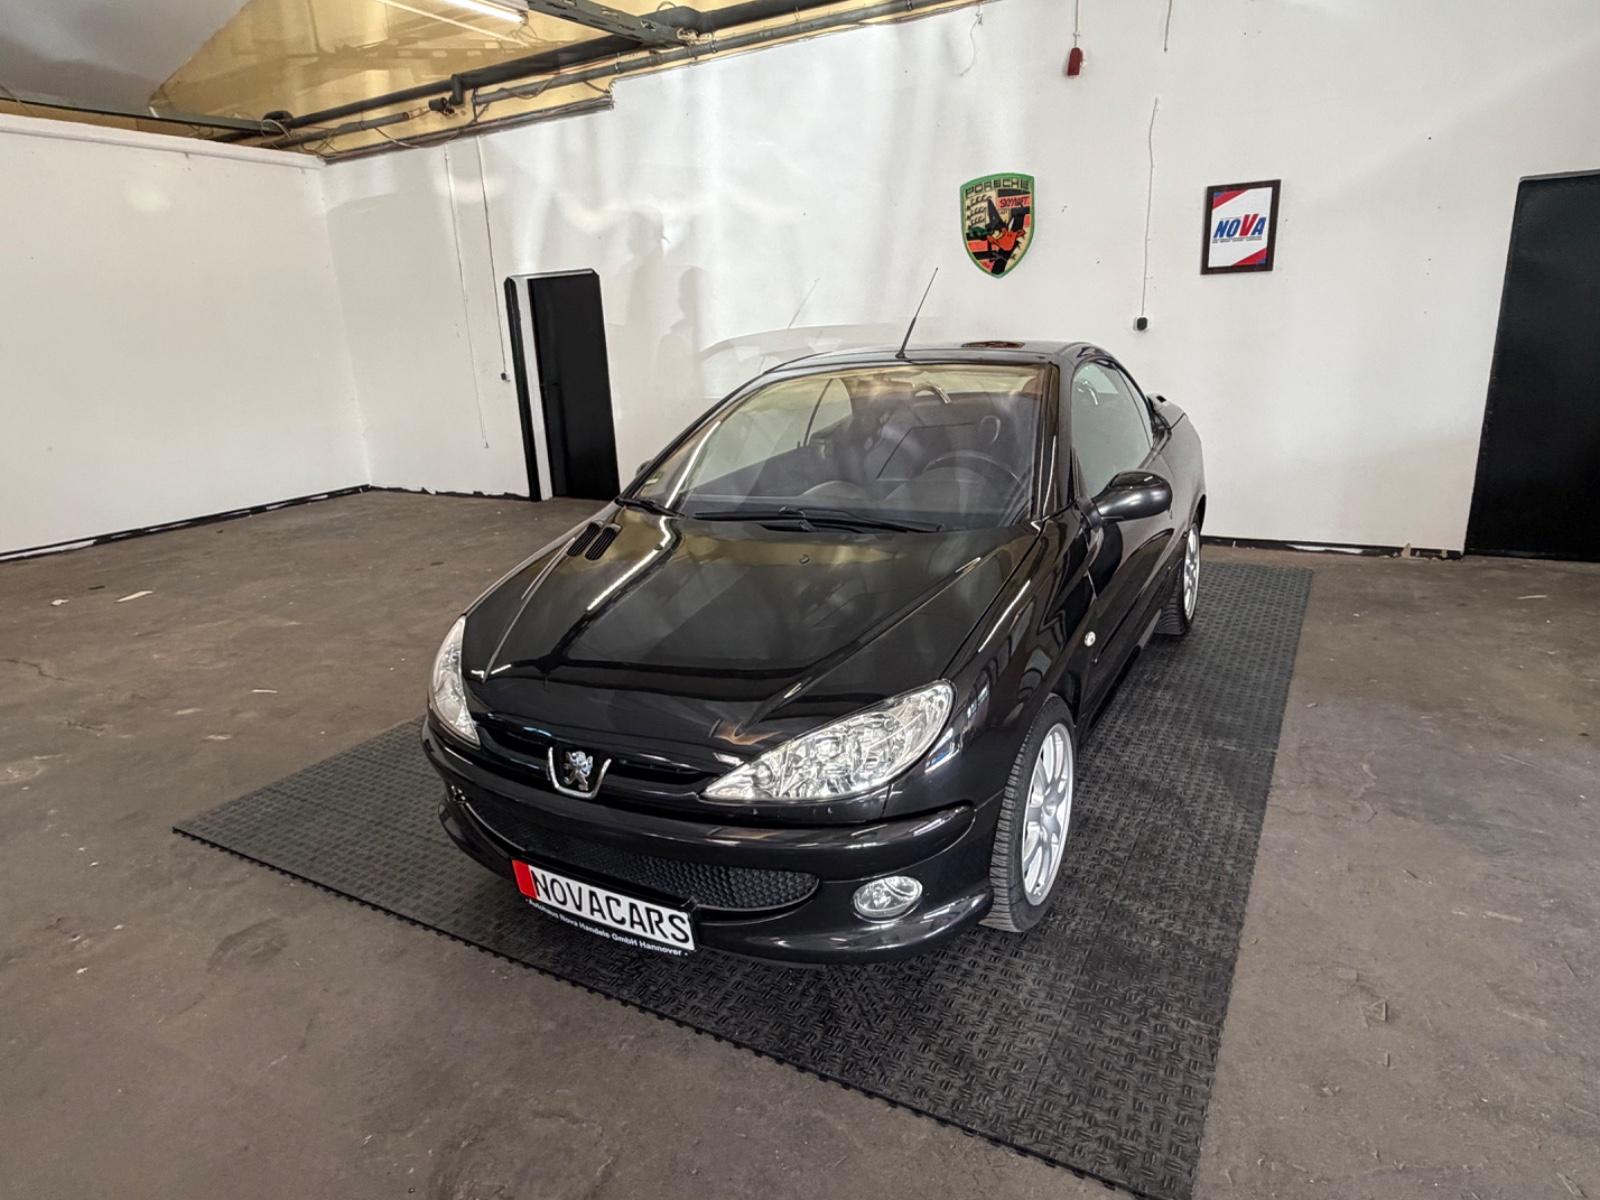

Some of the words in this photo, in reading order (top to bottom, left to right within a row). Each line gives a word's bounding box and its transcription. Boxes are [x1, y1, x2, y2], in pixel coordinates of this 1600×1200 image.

[965, 177, 1029, 200] PORSCHE
[1213, 213, 1267, 239] NOVA
[531, 870, 690, 943] NOVACARS
[559, 914, 578, 927] Nova
[578, 921, 610, 938] Handels
[611, 932, 637, 945] GmbH
[639, 940, 682, 956] Hannover
